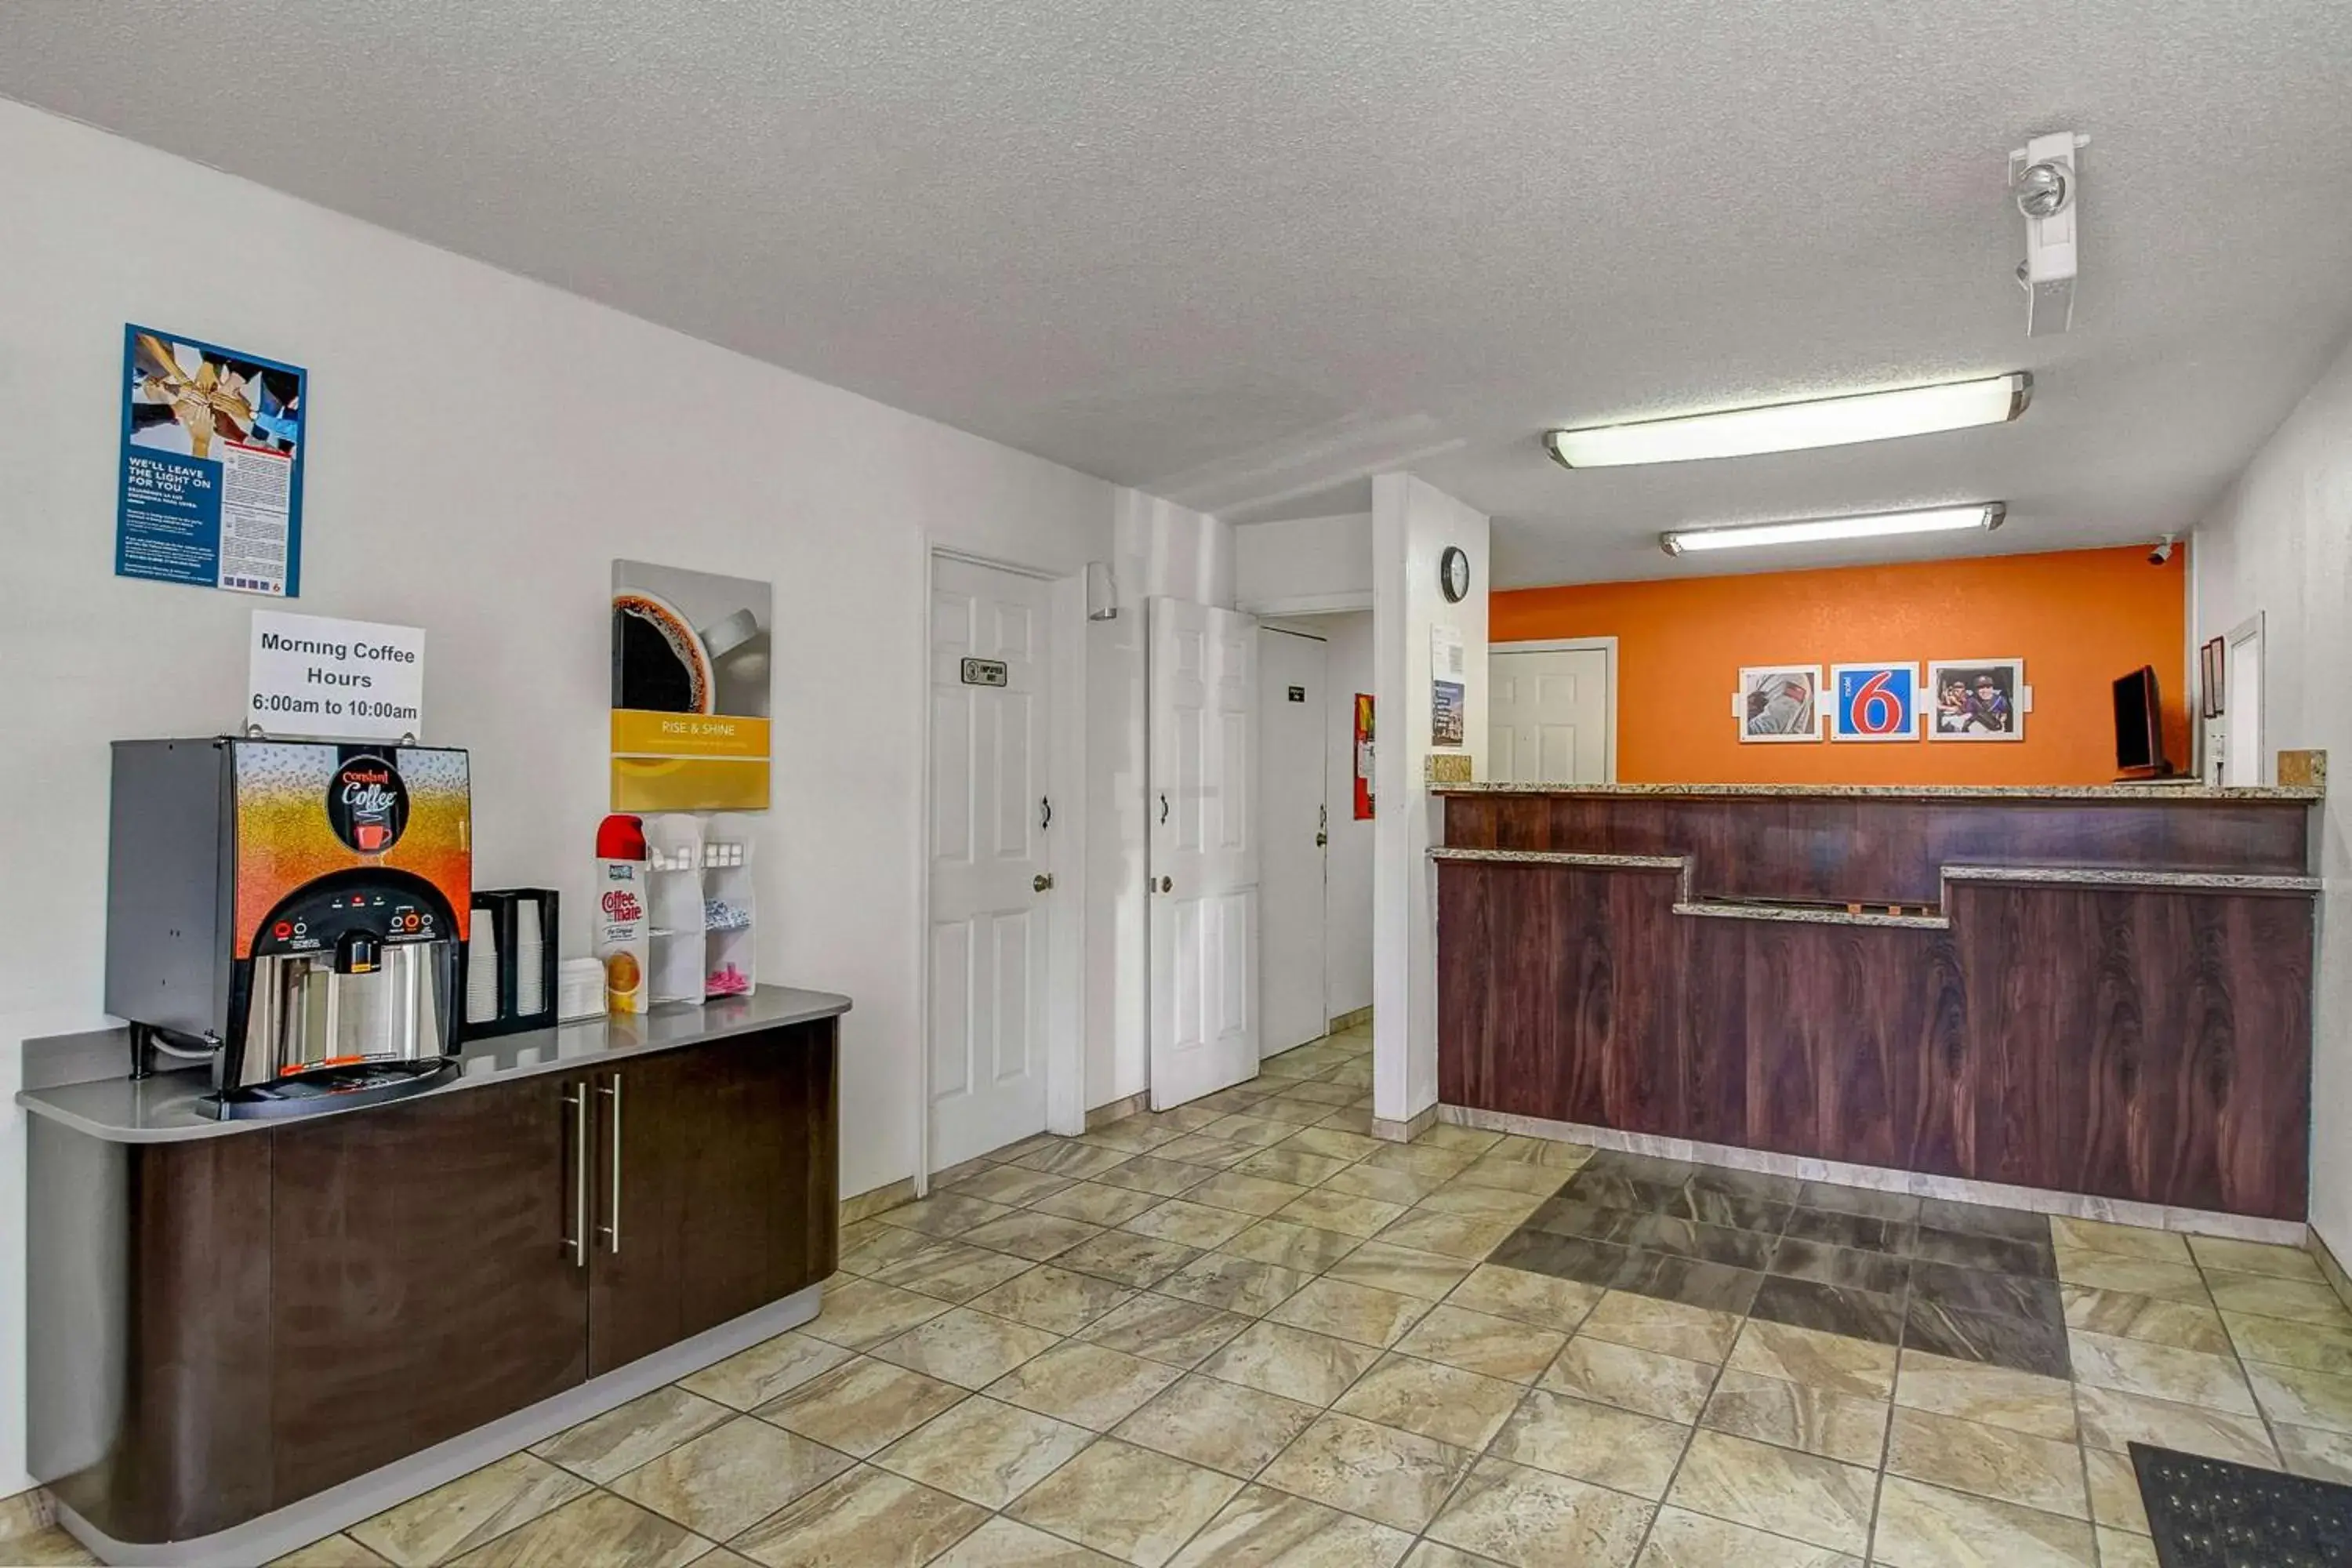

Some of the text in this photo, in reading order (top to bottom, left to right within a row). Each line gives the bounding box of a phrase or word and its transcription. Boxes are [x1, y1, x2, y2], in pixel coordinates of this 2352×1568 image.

[129, 456, 204, 478] WE'LL LEAVE
[129, 466, 211, 488] THE LIGHT ON
[129, 476, 153, 486] FOR
[156, 481, 185, 493] YOU.
[261, 633, 416, 664] Morning Coffee
[307, 667, 372, 688] Hours
[252, 693, 417, 720] 6:00am to 10:00am
[1851, 670, 1902, 735] 6
[662, 720, 735, 735] RISE & SHINE
[342, 782, 397, 812] Coffee
